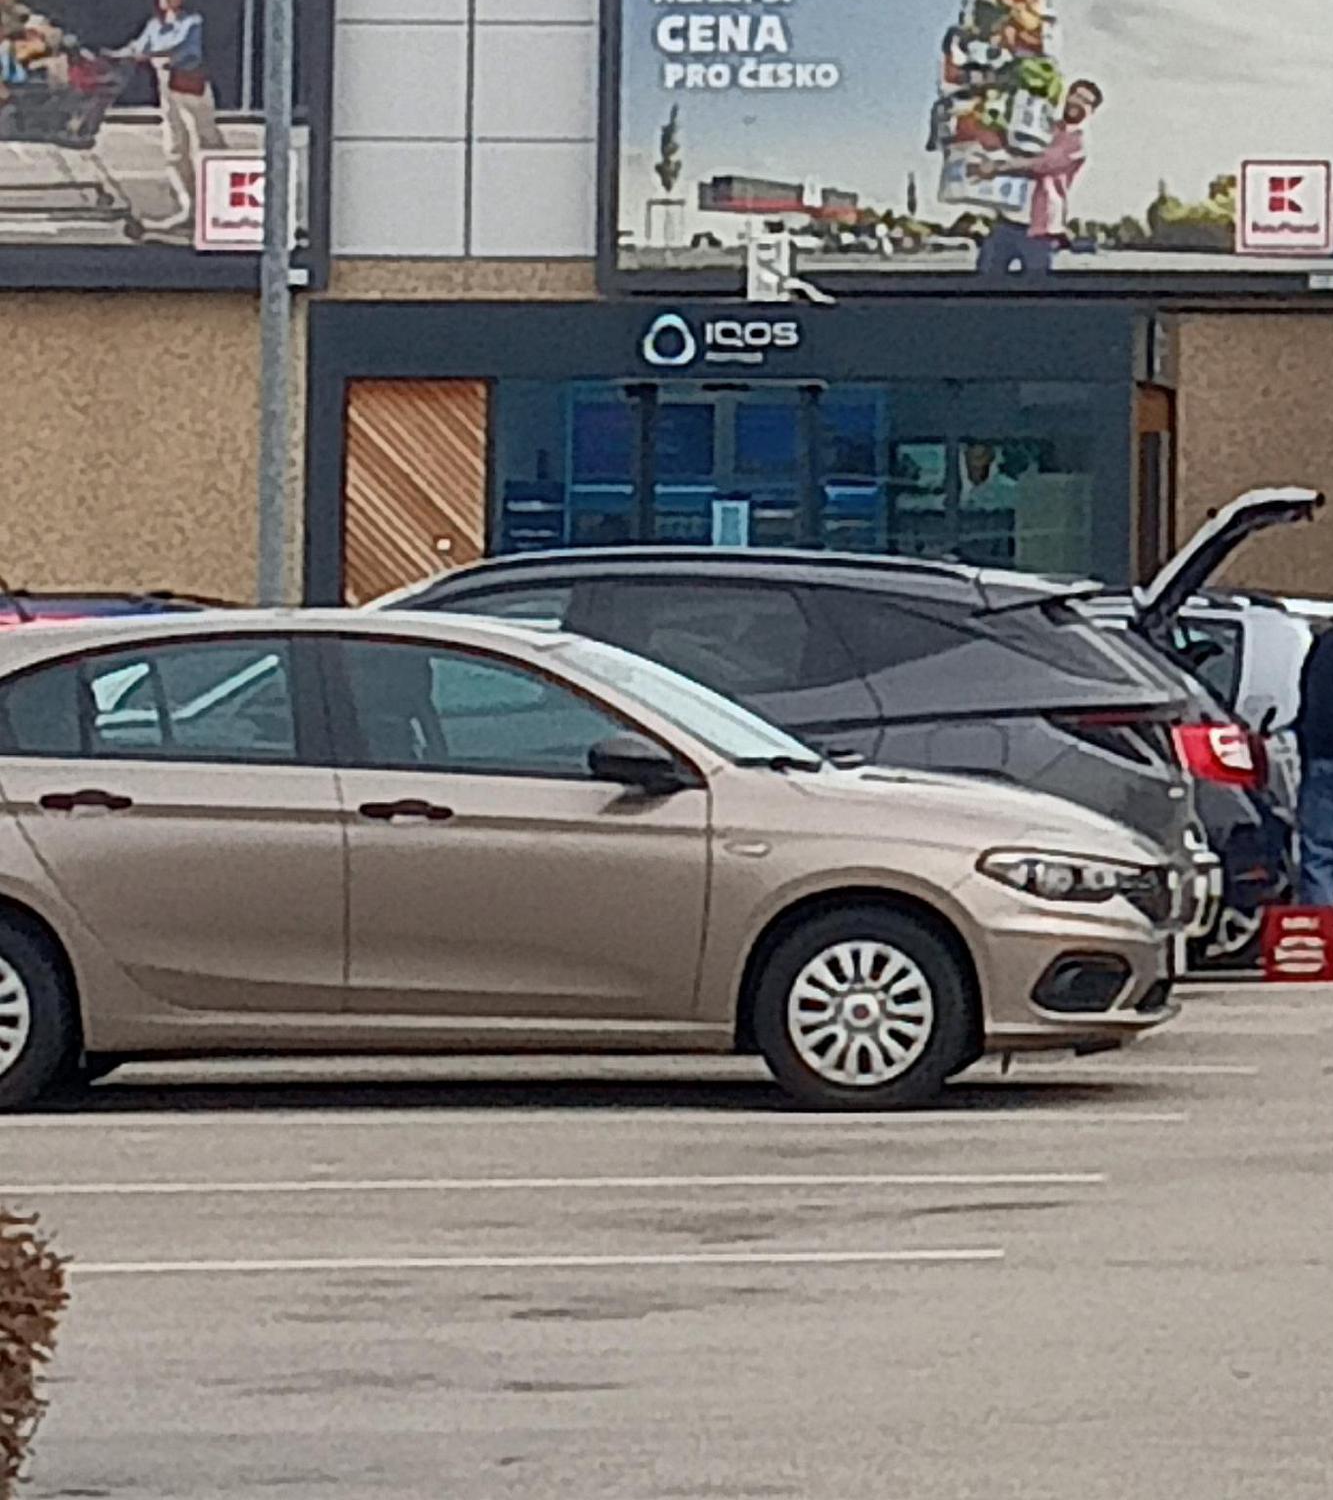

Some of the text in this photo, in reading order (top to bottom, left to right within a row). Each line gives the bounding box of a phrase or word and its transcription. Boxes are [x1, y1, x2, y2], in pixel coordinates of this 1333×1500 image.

[657, 15, 788, 52] CENA
[664, 63, 731, 88] PRO
[738, 57, 839, 88] ČESKO
[705, 321, 799, 347] IQOS
